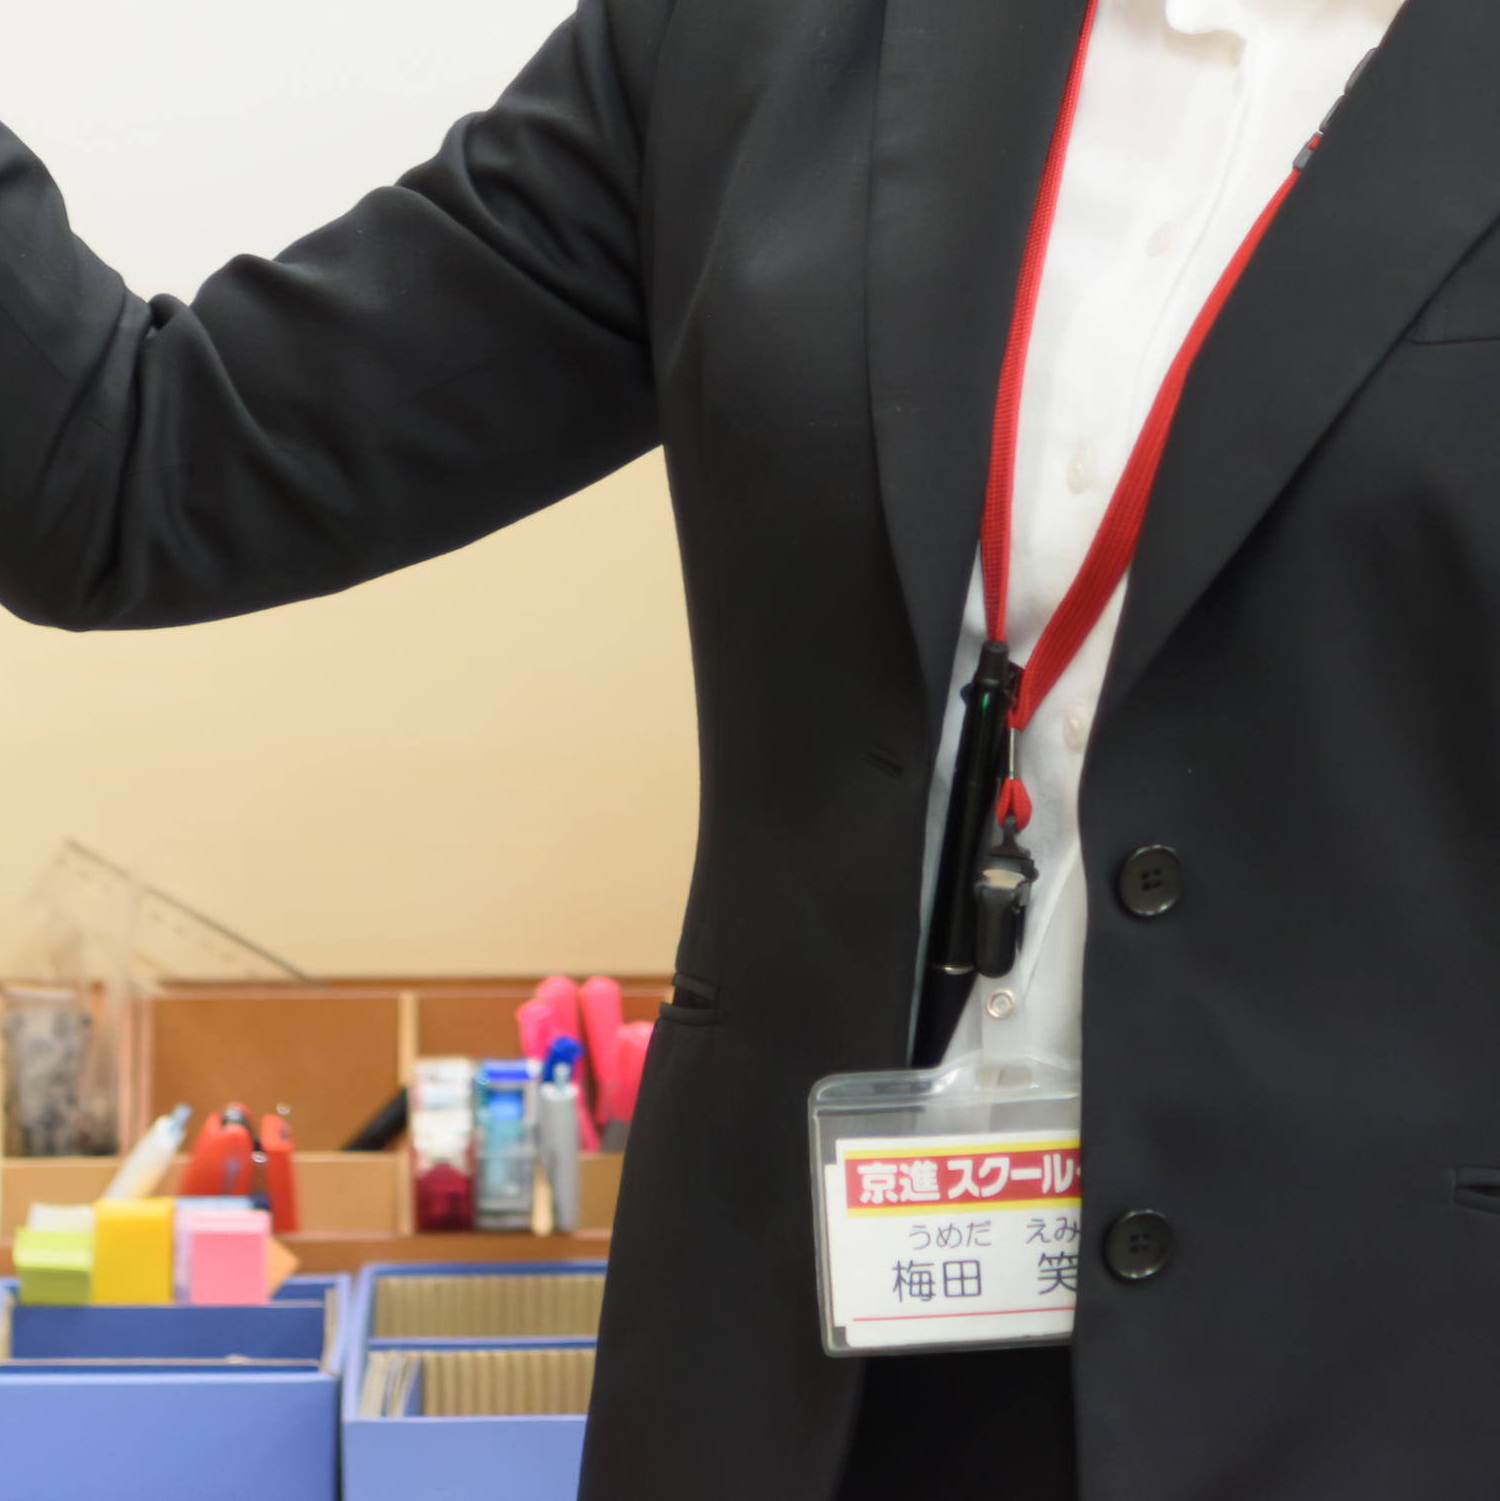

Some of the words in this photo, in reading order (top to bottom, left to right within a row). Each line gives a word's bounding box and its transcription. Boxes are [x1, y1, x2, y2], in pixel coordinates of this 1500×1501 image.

[908, 1220, 992, 1250] うめだ
[1025, 1216, 1081, 1245] えみ
[891, 1259, 983, 1303] 梅田
[1036, 1250, 1078, 1296] 笑
